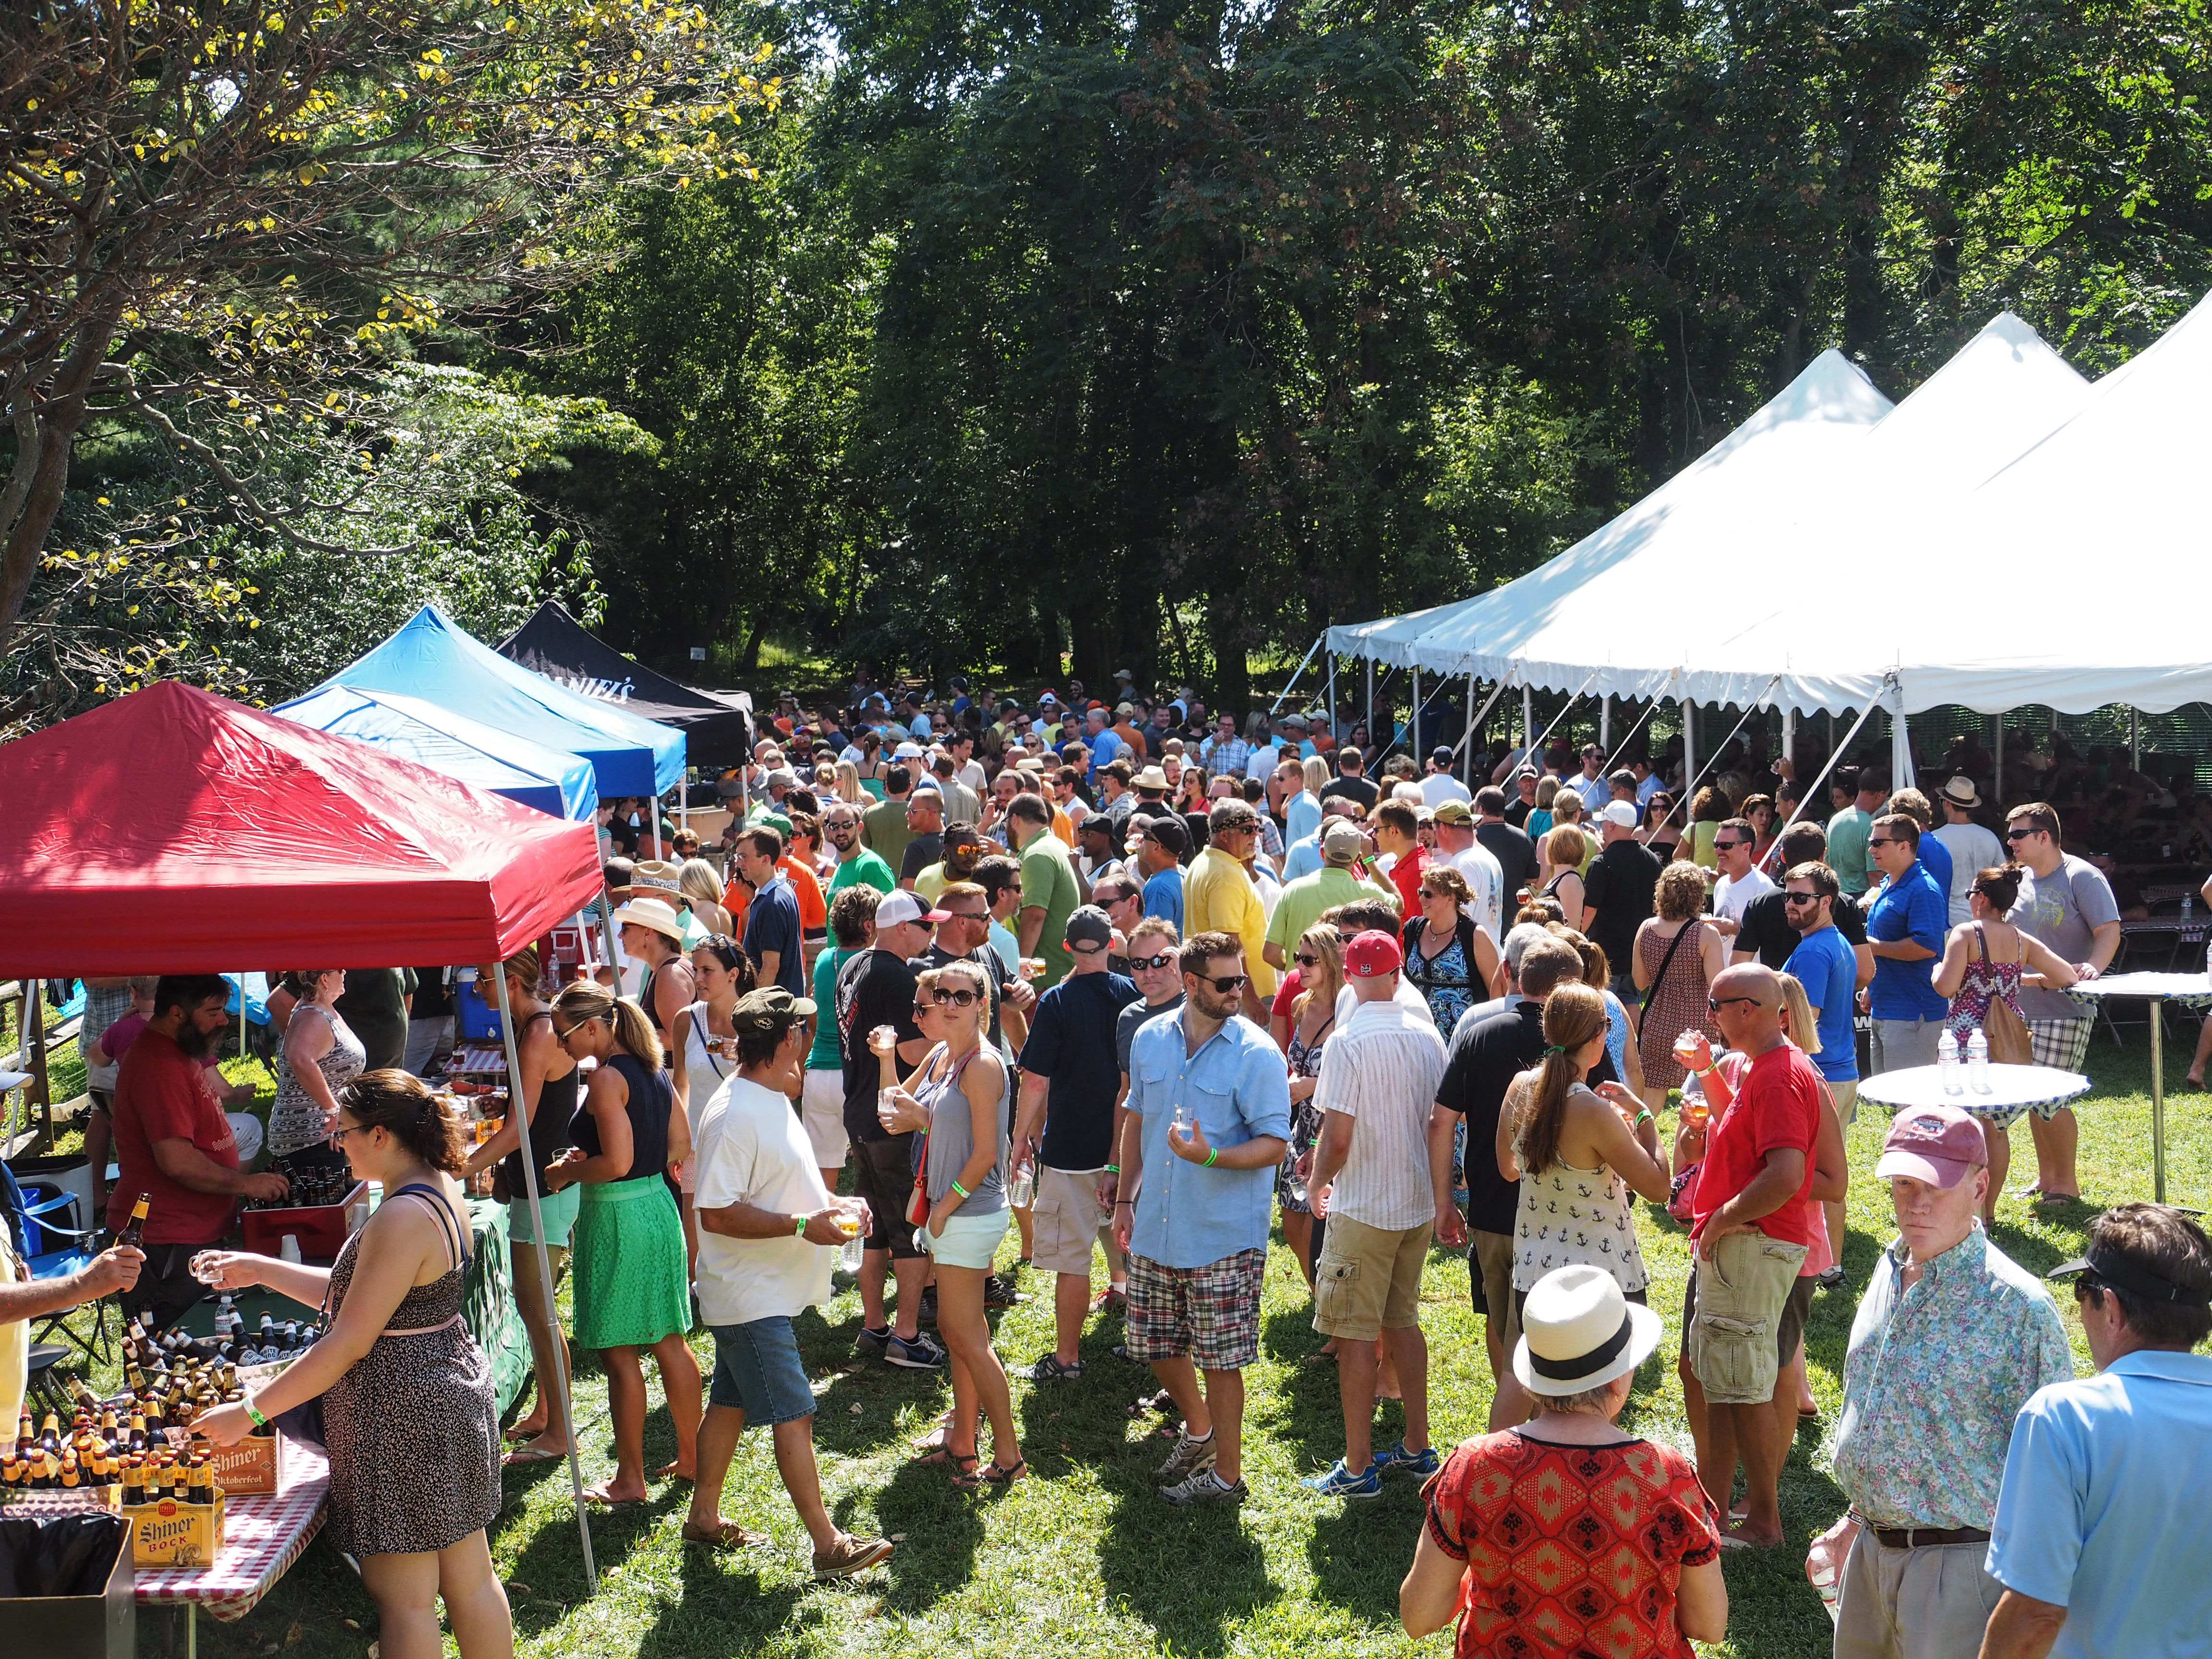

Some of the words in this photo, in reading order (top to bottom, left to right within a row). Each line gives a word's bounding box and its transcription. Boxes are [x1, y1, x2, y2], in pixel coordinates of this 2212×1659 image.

[211, 1447, 262, 1475] Shiner
[139, 1517, 195, 1544] Shiner
[148, 1536, 187, 1552] BOCK
